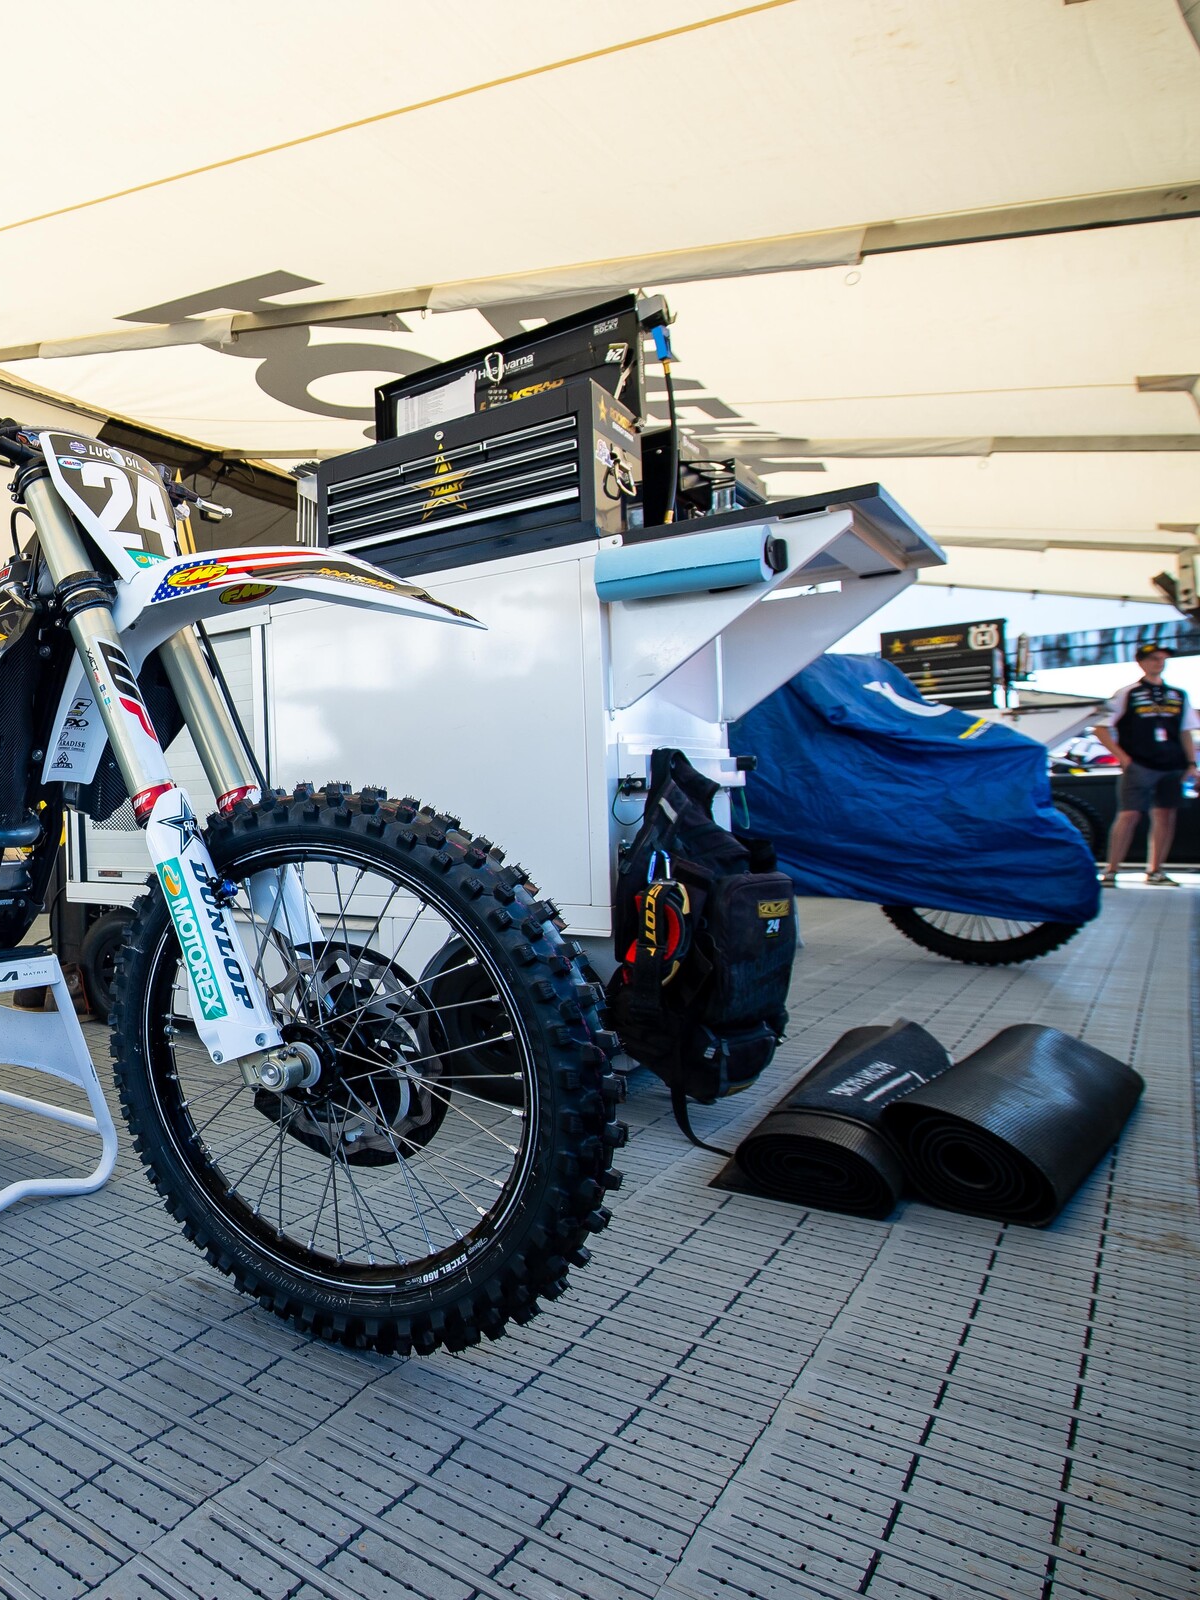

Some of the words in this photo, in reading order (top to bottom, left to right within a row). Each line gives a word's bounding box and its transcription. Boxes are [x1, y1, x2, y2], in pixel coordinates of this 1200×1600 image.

[593, 322, 619, 336] ROCKY
[88, 444, 114, 460] LUC
[125, 456, 142, 471] OIL
[81, 461, 180, 556] 24
[189, 859, 255, 1010] DUNLOP
[766, 918, 781, 934] 24
[171, 896, 223, 1015] MOTOREX
[22, 969, 49, 977] MATRIX
[439, 1253, 468, 1274] EXCEL
